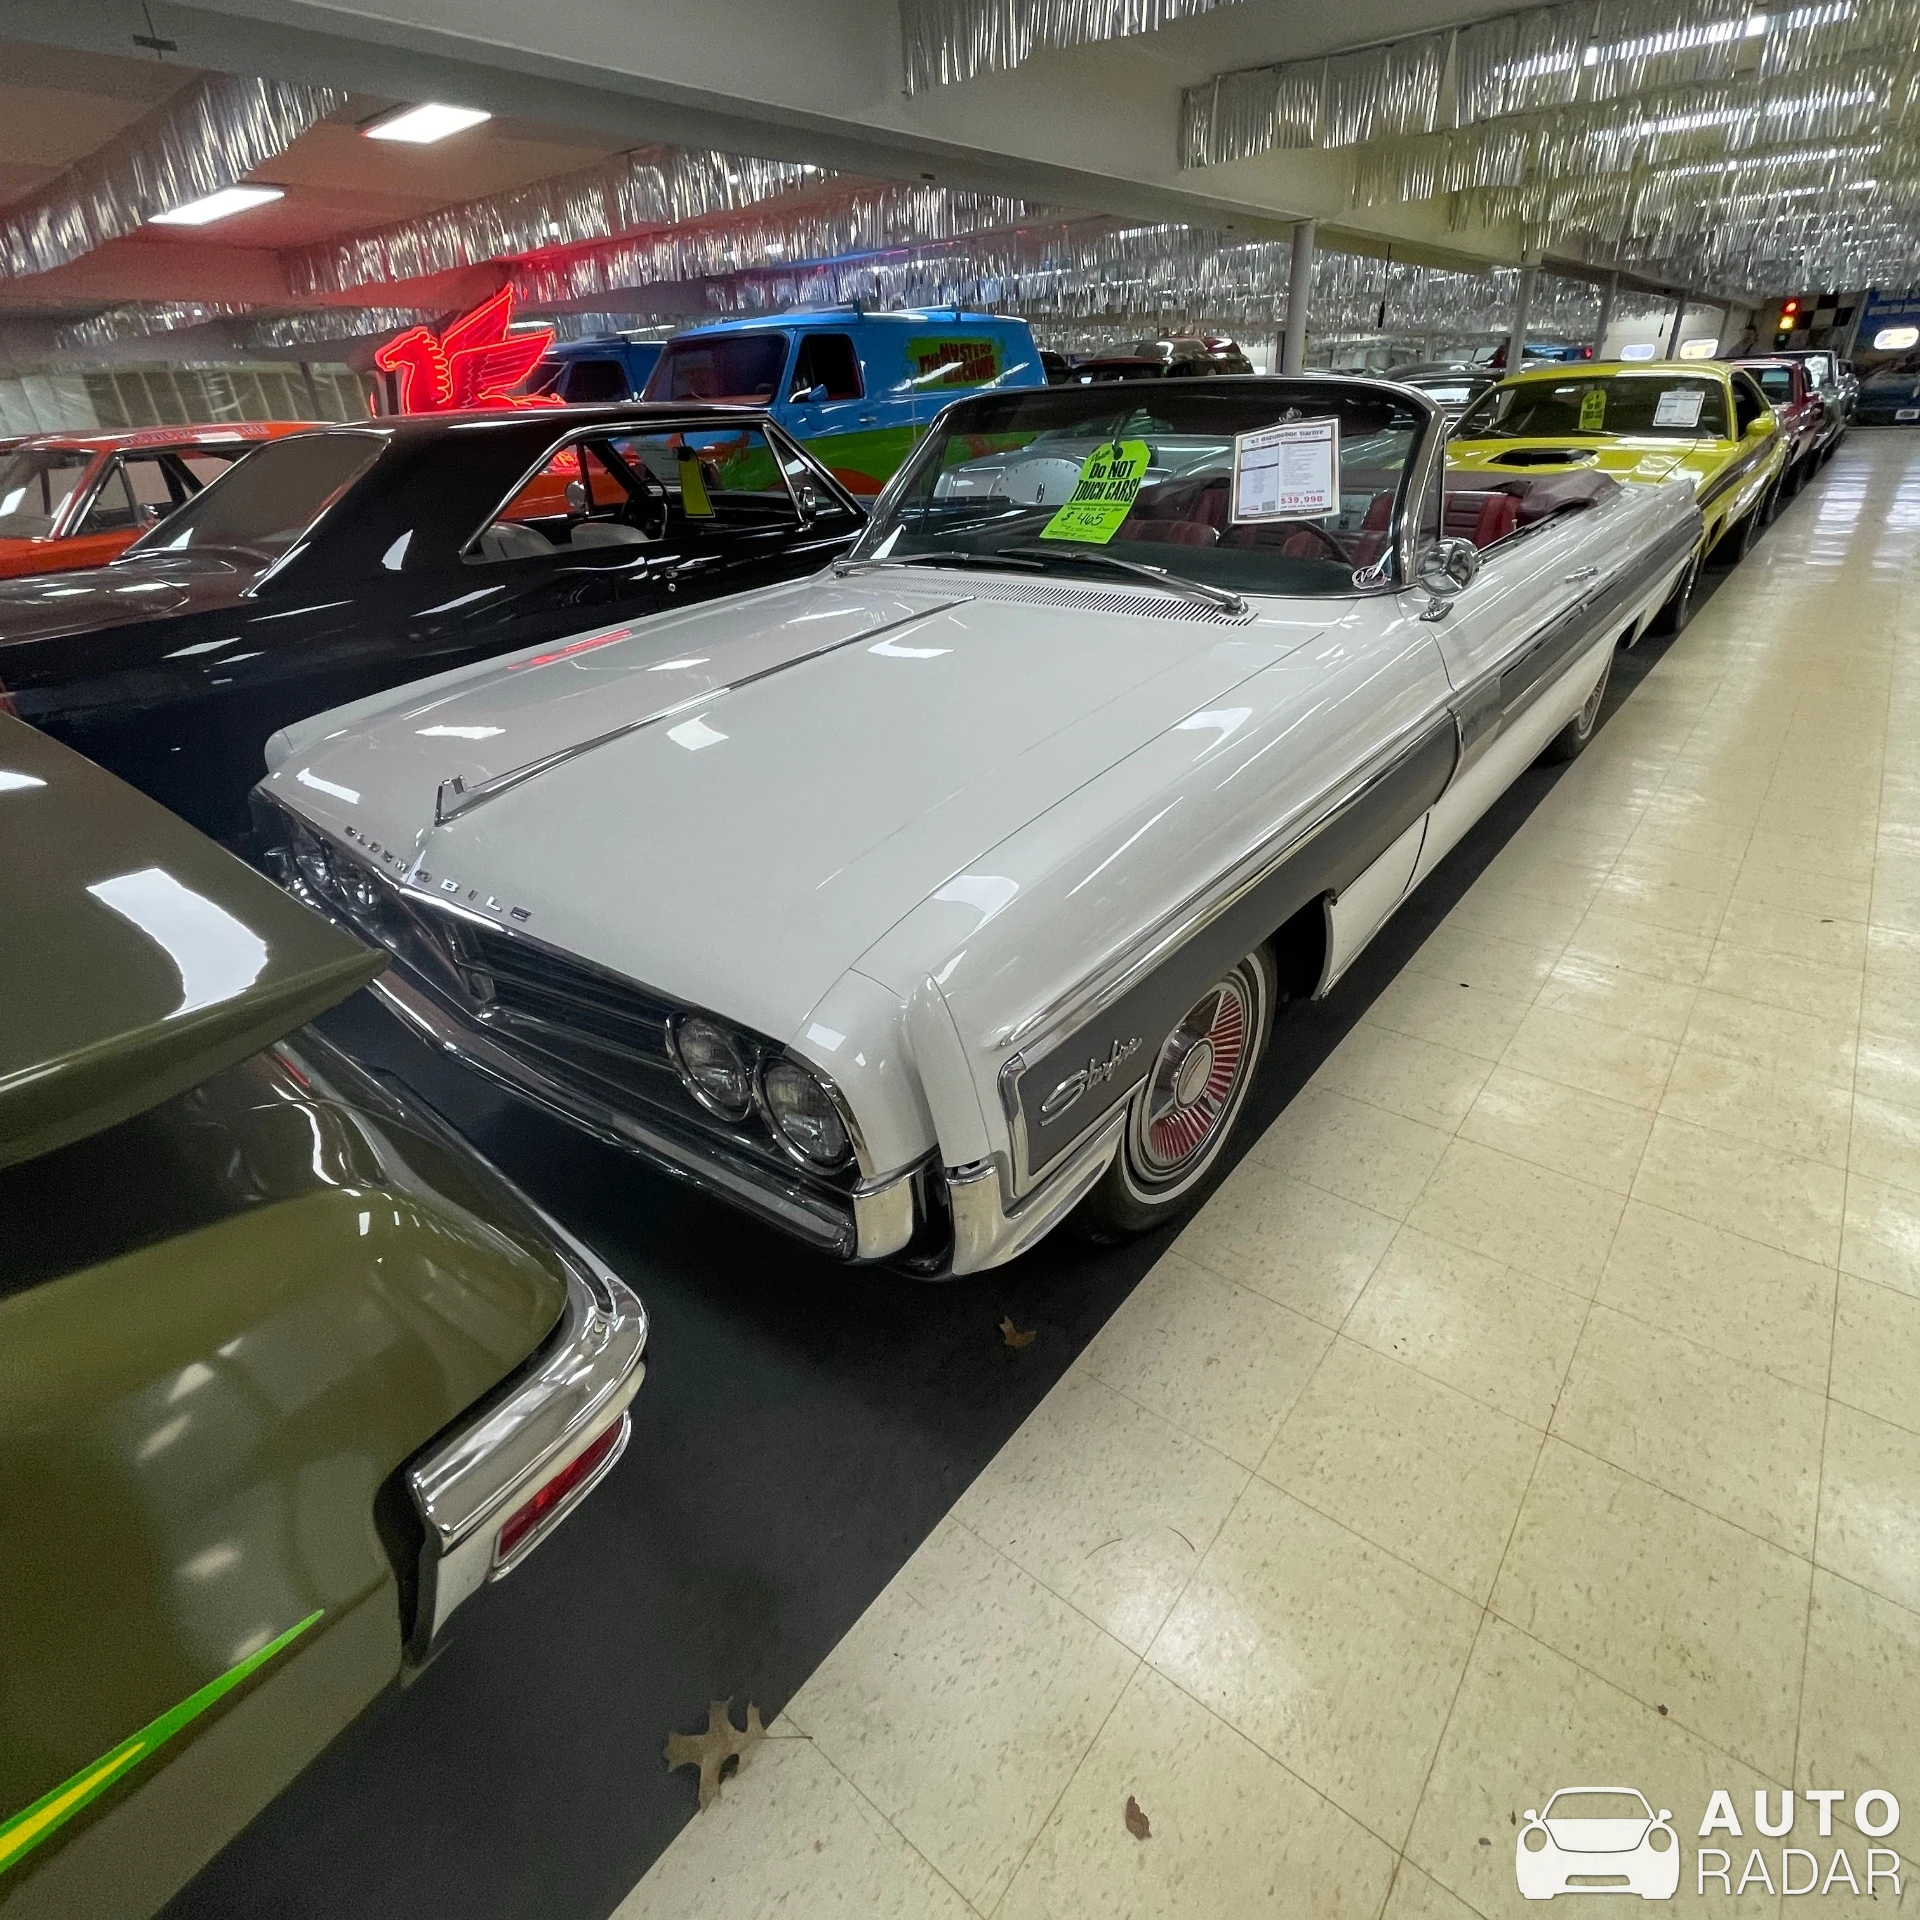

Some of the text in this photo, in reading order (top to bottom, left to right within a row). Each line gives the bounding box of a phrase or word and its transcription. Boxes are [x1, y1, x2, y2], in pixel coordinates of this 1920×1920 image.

[1108, 460, 1136, 478] NOT
[1071, 477, 1140, 502] TOUCH CARS!
[1281, 495, 1323, 505] $39,998
[1077, 512, 1106, 526] 465
